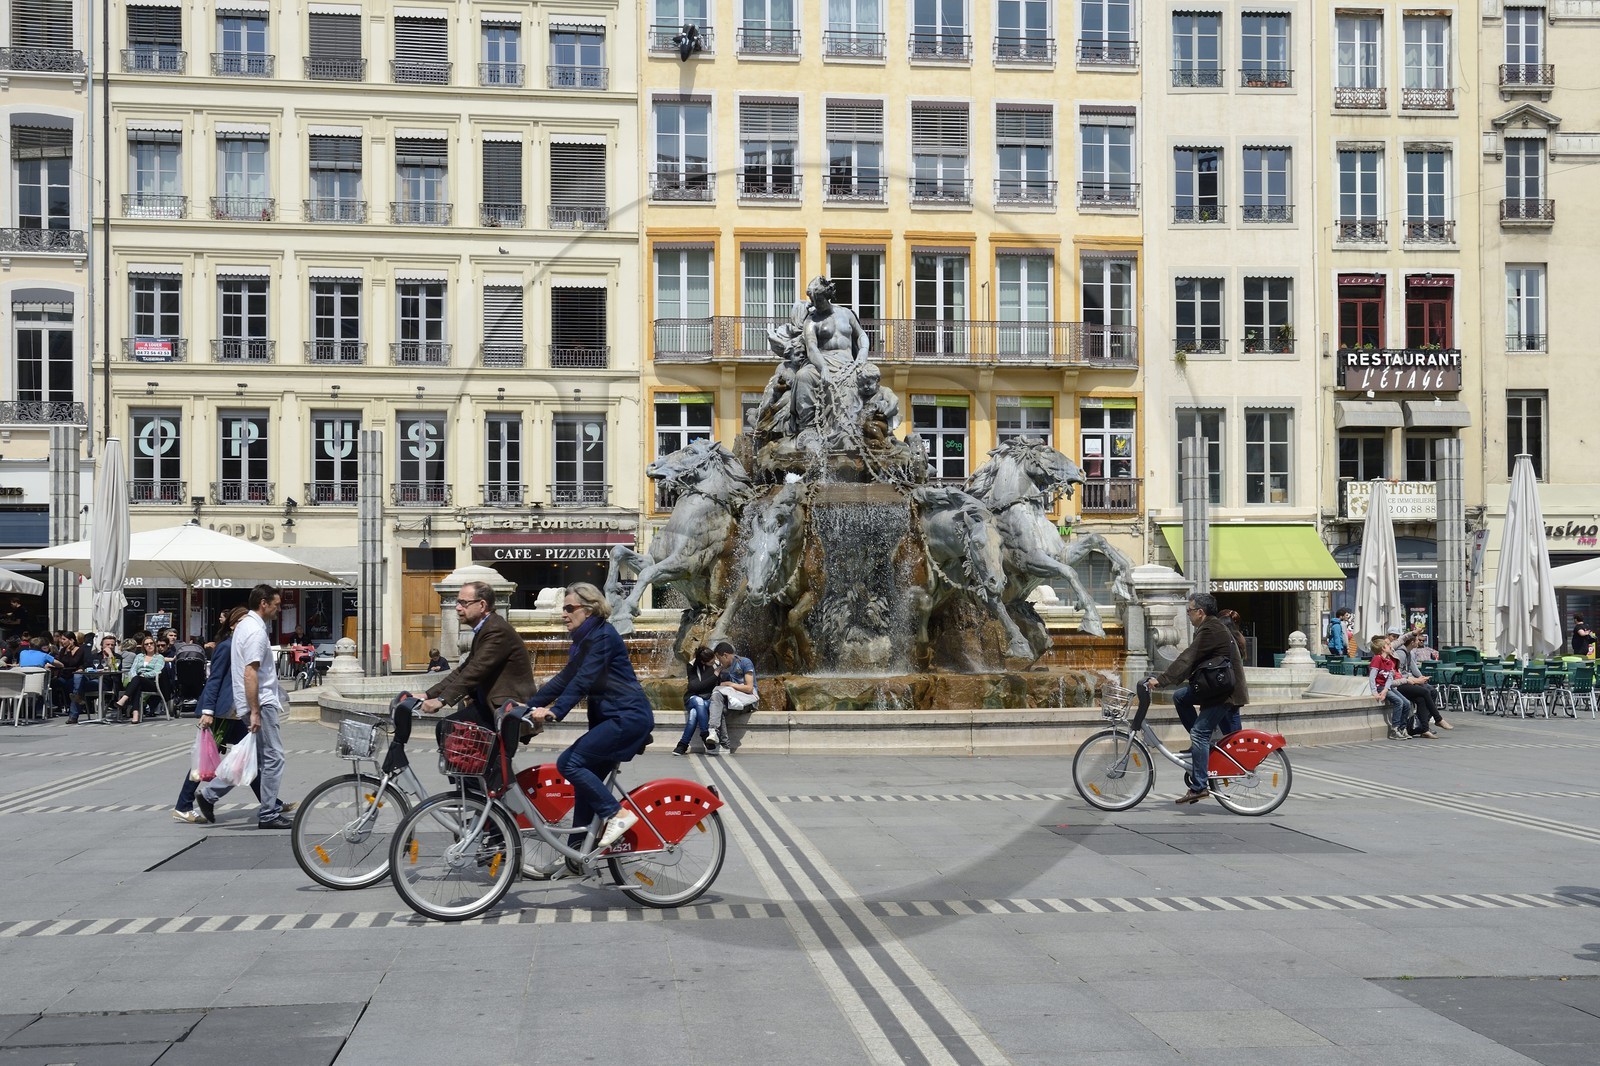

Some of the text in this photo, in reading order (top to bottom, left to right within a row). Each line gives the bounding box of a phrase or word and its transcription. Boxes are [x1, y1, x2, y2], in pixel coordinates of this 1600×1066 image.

[1347, 353, 1460, 366] RESTAURANT
[1396, 506, 1408, 514] 00
[1410, 506, 1422, 514] 88
[1425, 506, 1436, 514] 88
[489, 515, 619, 529] La Fontaine
[1543, 521, 1598, 537] asino
[494, 549, 532, 560] CAFE
[545, 549, 610, 560] PIZZERIA
[1306, 580, 1344, 591] CHAUDES
